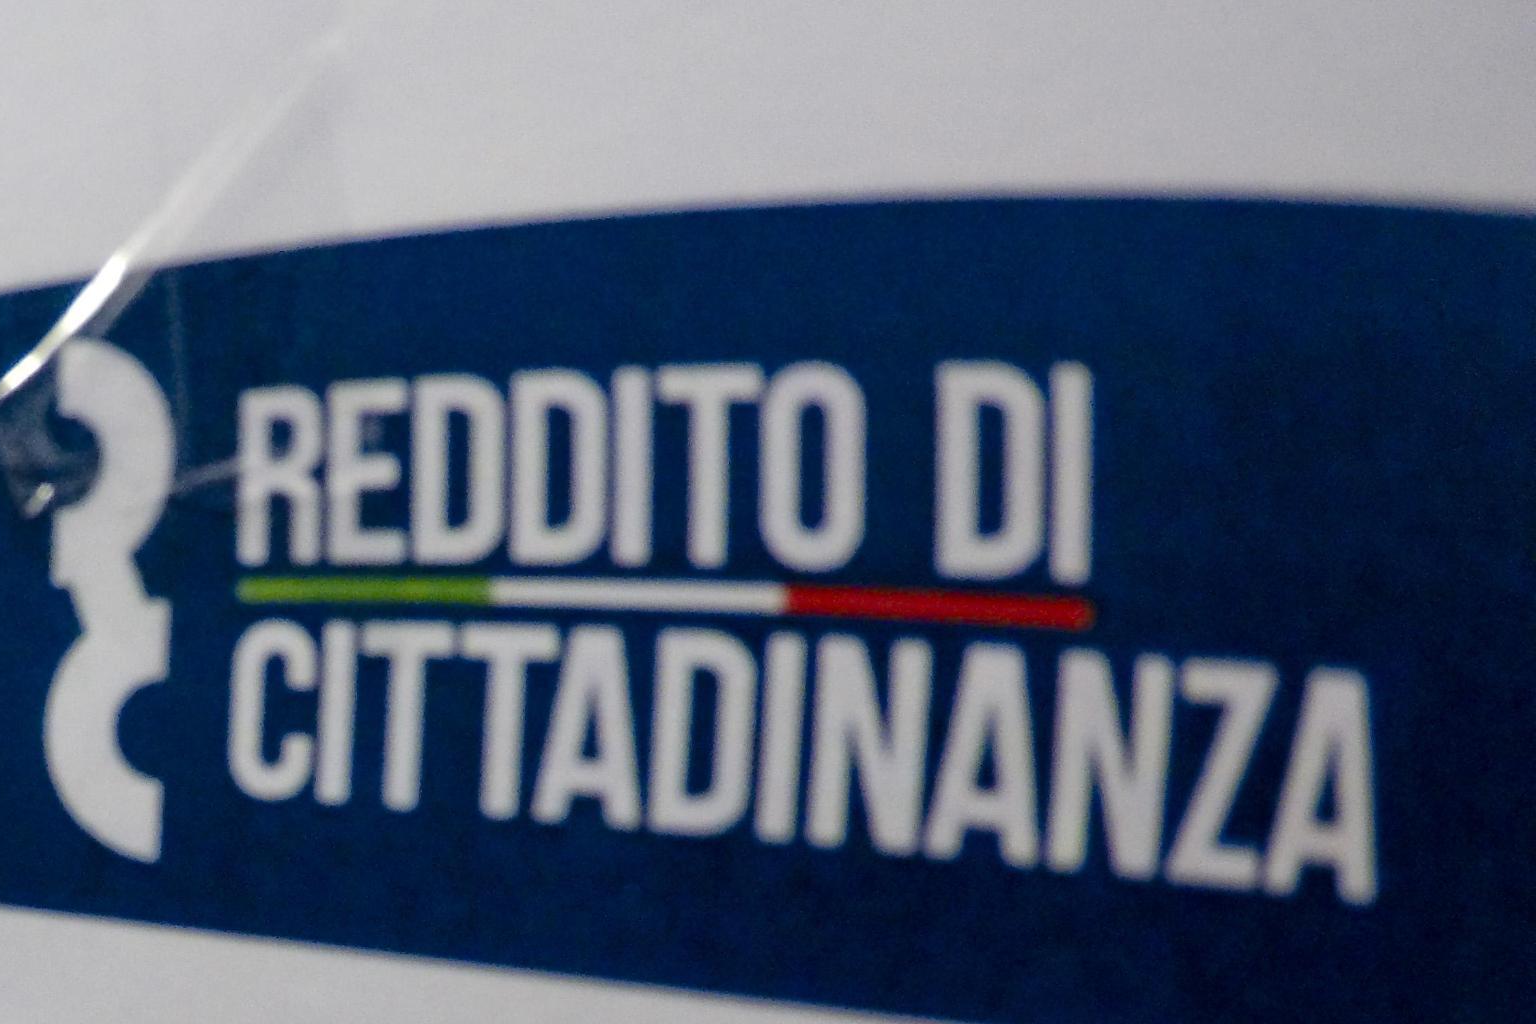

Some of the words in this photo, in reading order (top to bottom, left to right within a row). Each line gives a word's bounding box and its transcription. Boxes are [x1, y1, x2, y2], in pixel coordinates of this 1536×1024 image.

[236, 360, 868, 566] REDDITO
[934, 360, 1092, 584] DI
[227, 619, 1378, 905] CITTADINANZA
